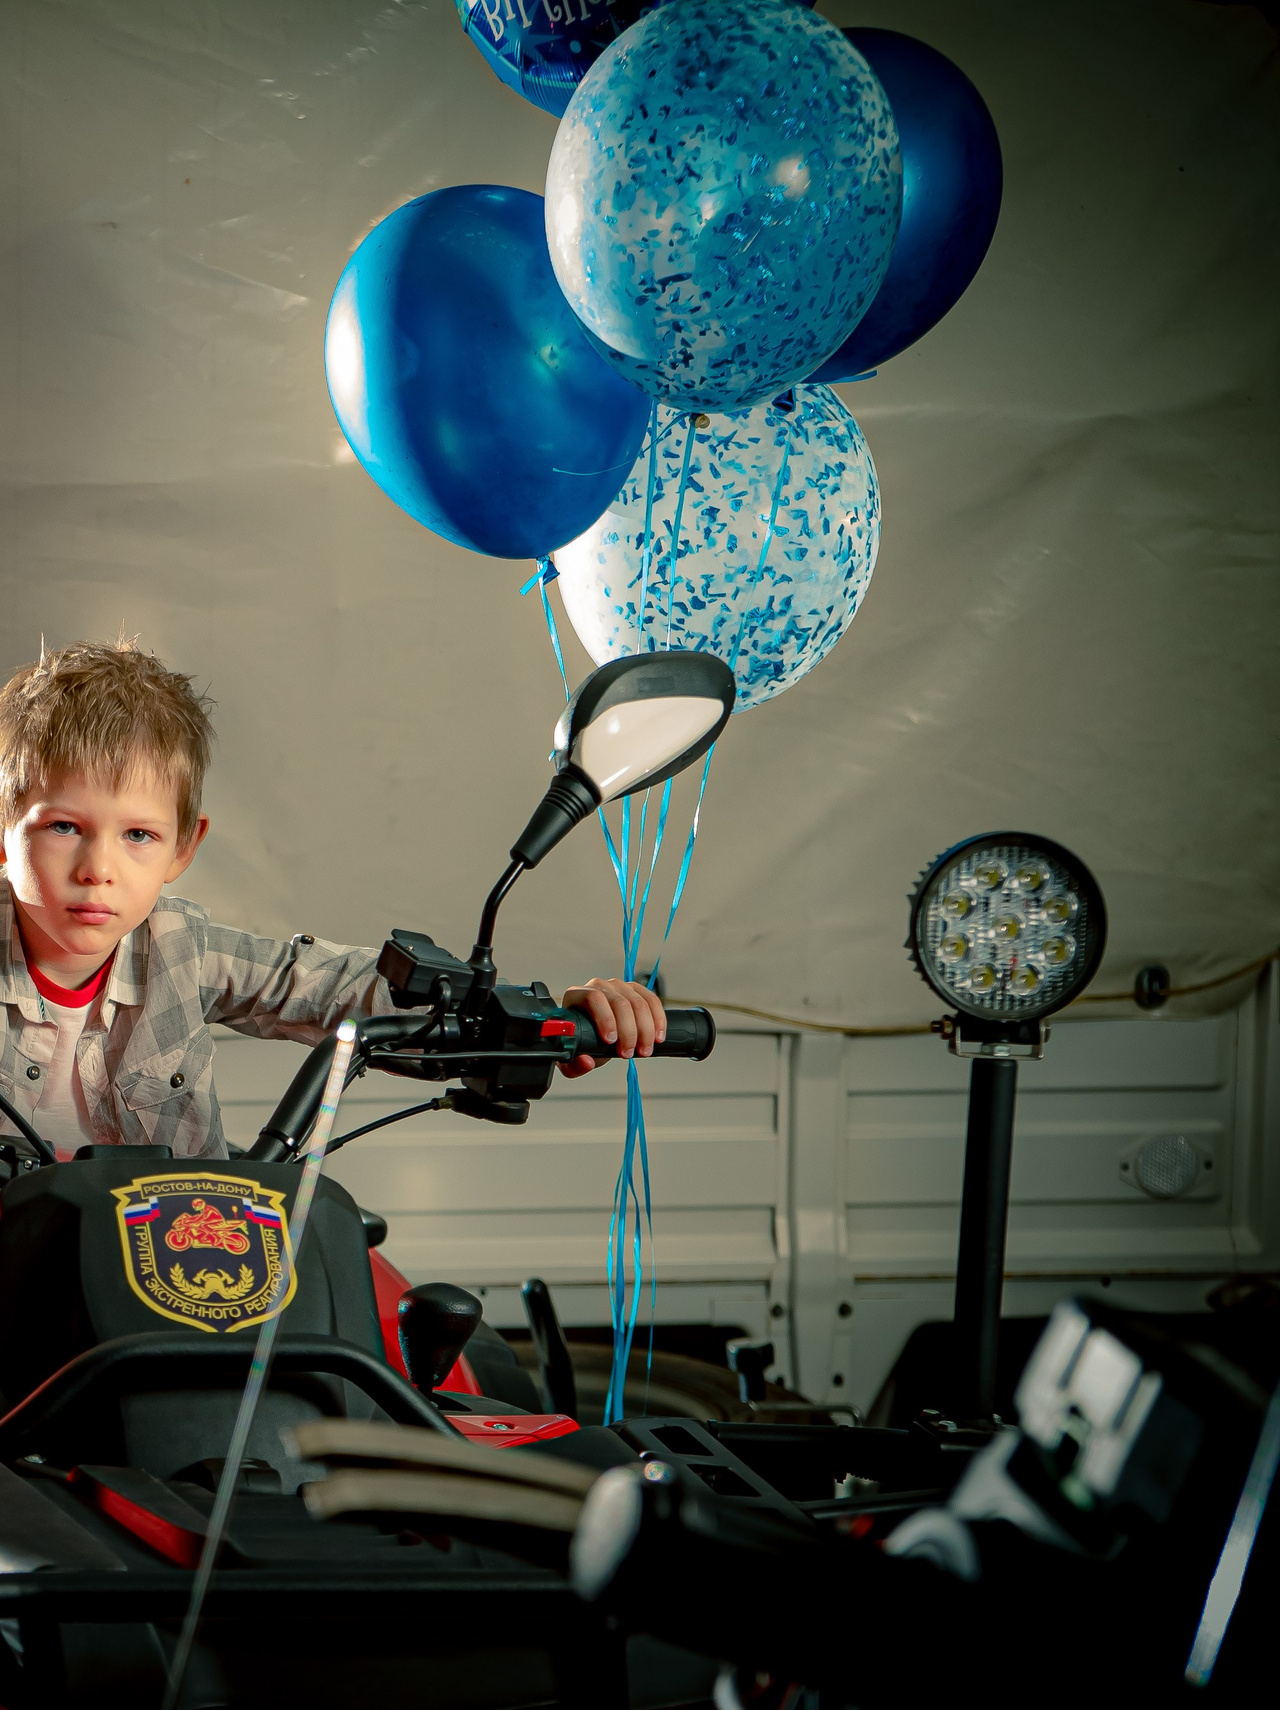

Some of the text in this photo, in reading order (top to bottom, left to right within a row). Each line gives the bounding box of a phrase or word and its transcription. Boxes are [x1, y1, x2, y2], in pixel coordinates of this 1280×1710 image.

[143, 1182, 252, 1196] РОСТОВ-НА-ДОНУ
[134, 1225, 284, 1320] ГРУППА ЭКСТРЕННОГО РЕАГИРОВАНИЯ
